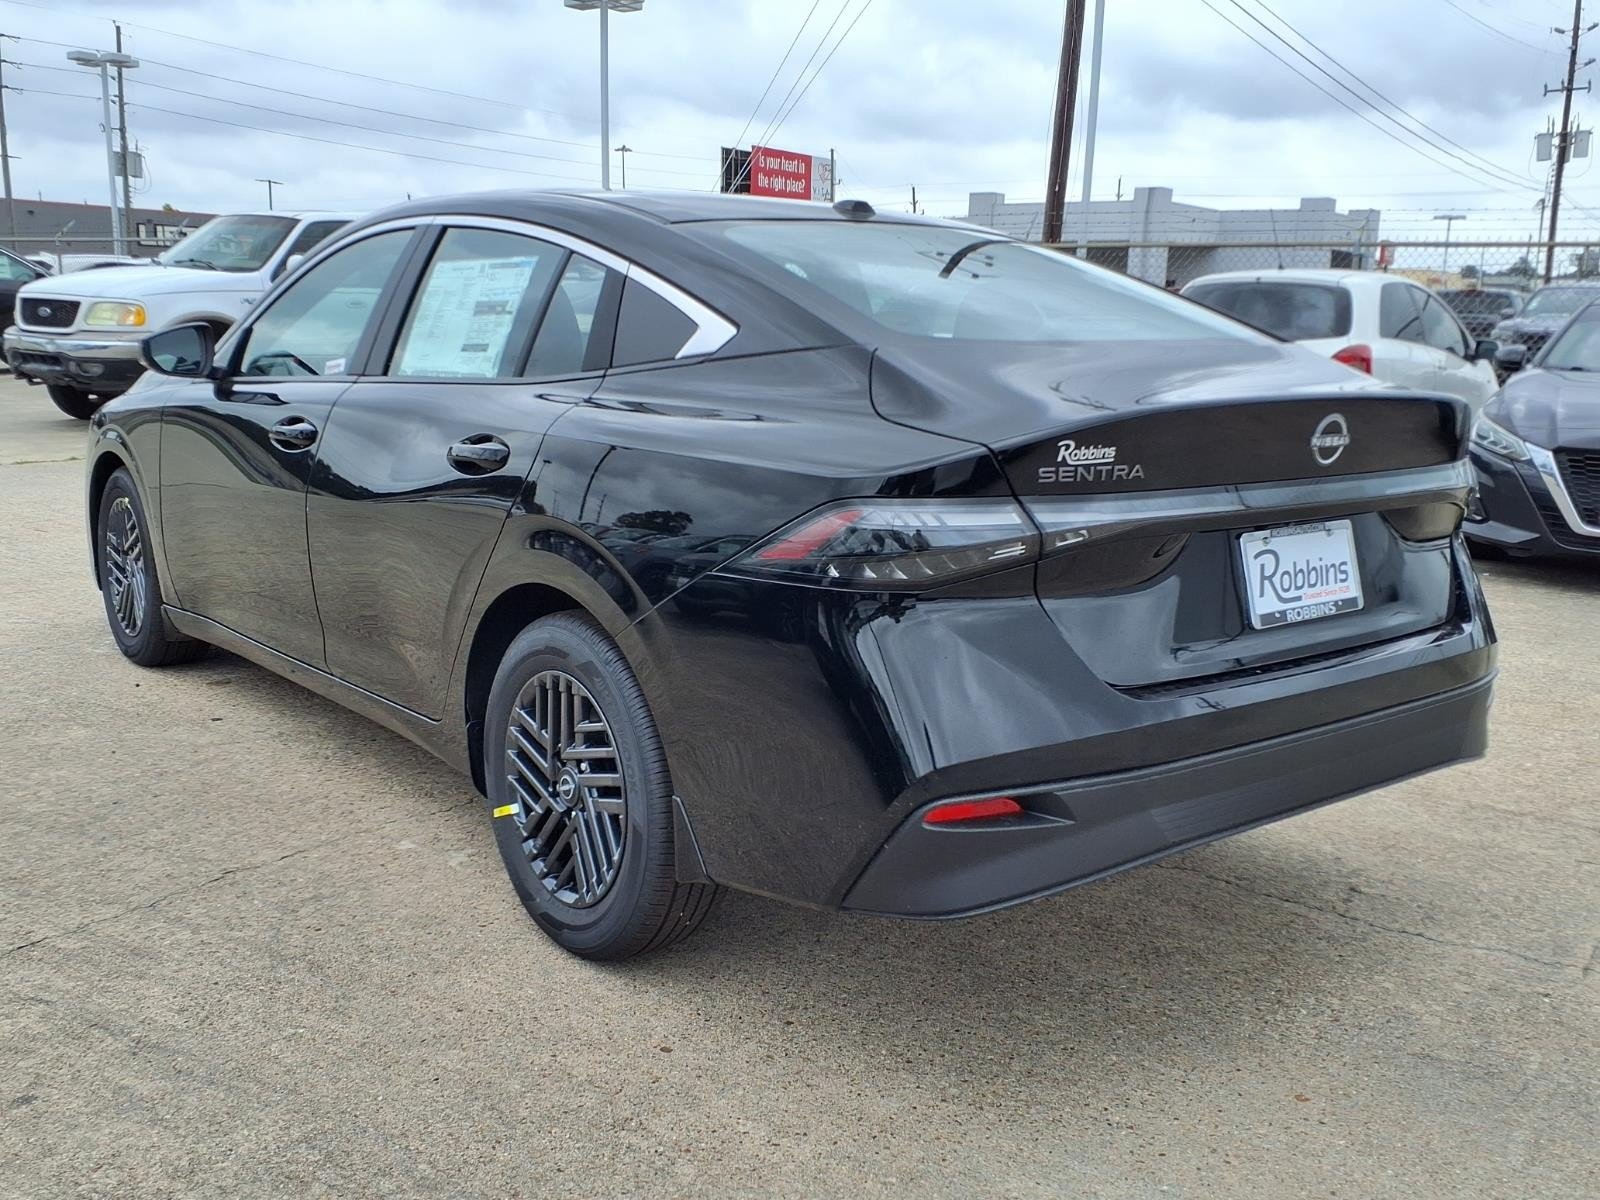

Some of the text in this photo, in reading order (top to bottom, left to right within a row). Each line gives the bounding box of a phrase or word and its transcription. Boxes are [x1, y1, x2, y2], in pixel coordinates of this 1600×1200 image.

[759, 154, 805, 175] Is your heart in
[758, 173, 806, 193] the right place?
[1057, 440, 1117, 465] Robbins
[1038, 464, 1145, 483] SENTRA
[1253, 549, 1349, 604] Robbins
[1286, 602, 1337, 622] ROBBINS
